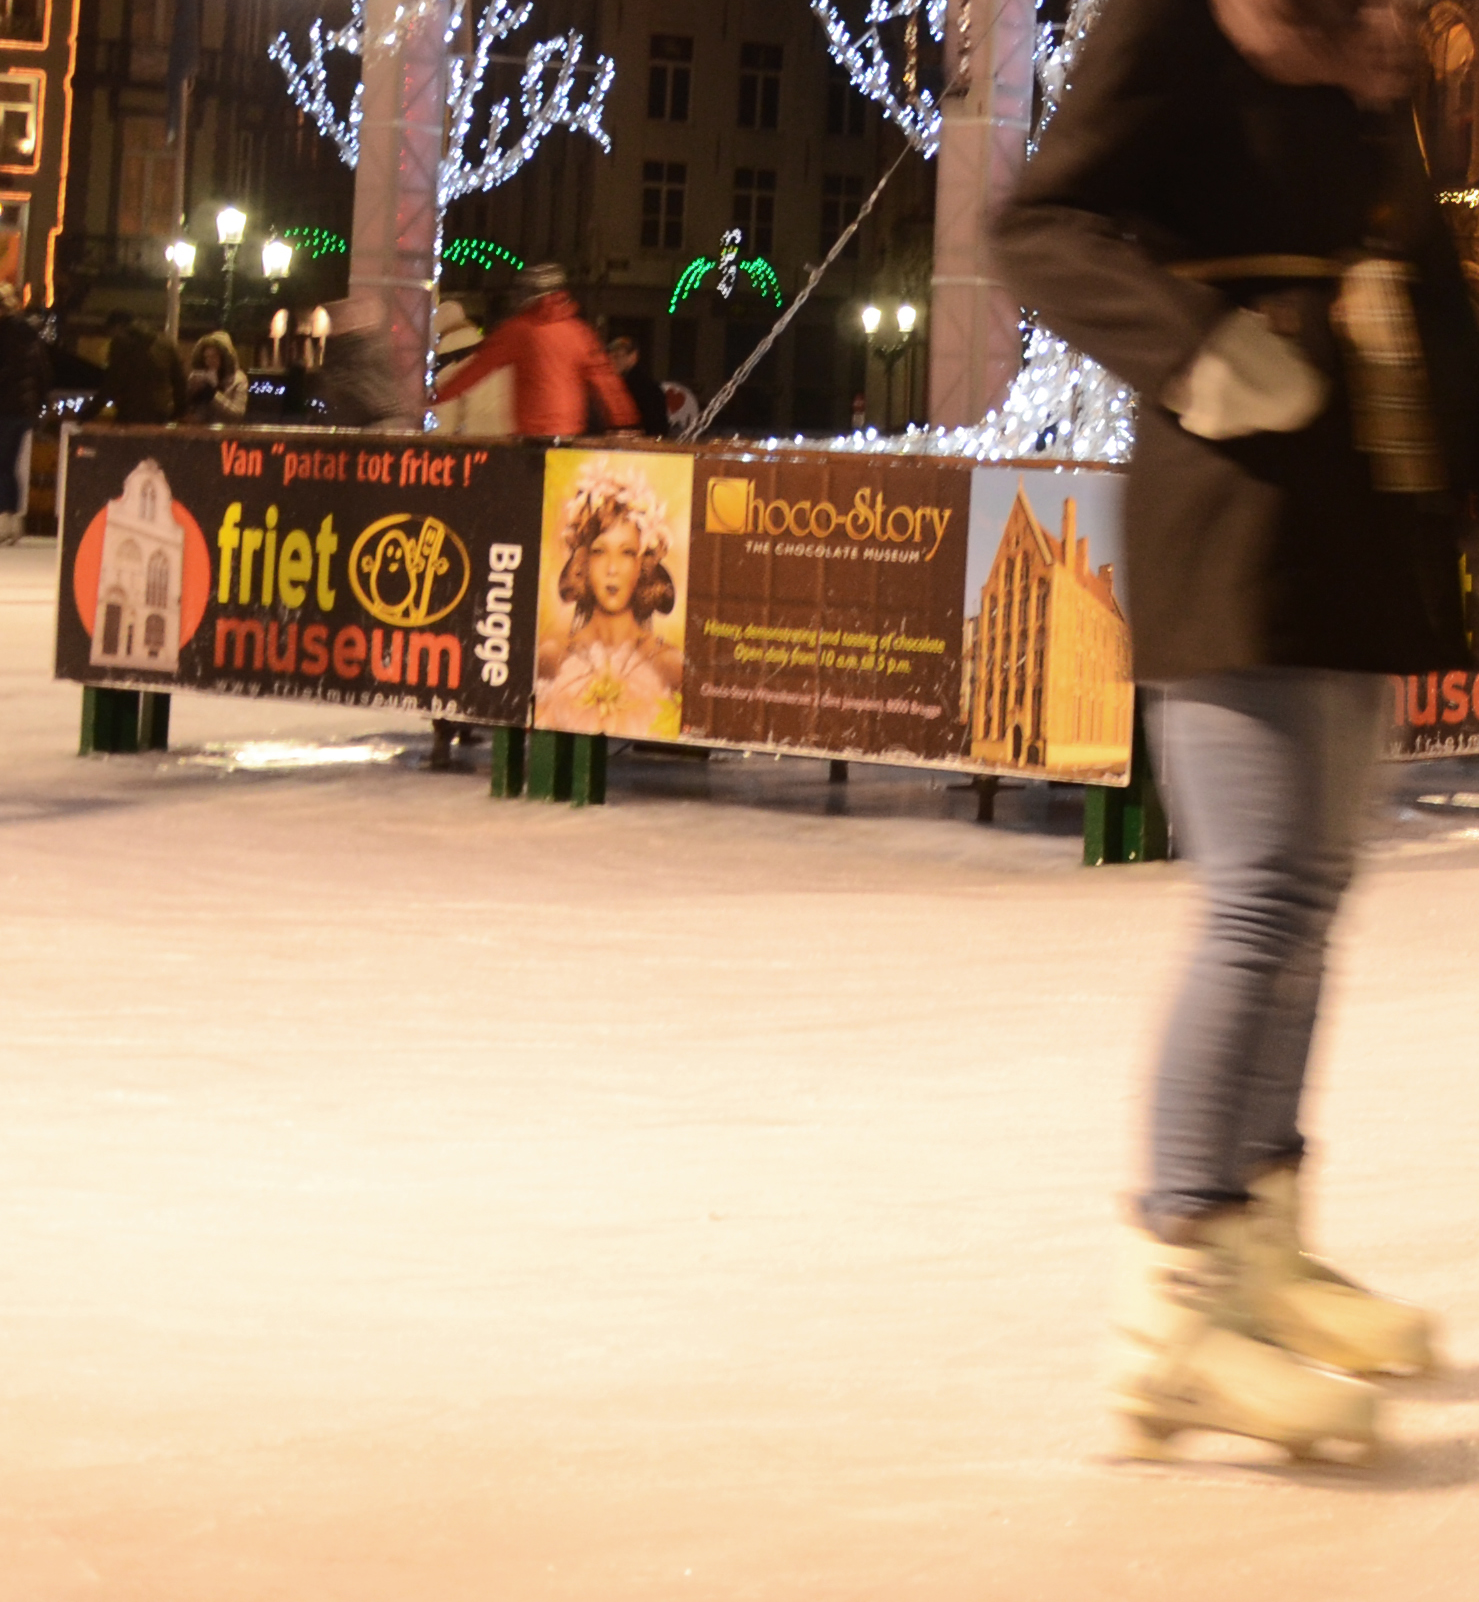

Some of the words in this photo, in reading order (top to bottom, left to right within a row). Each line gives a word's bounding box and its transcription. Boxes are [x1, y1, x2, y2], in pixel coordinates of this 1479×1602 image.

[221, 441, 263, 477] Van
[356, 451, 395, 484] tot
[399, 448, 456, 488] friet
[705, 477, 952, 562] Choco-Story
[217, 502, 338, 612] friet
[744, 541, 769, 555] THE
[775, 542, 858, 559] CHOCOLATE
[863, 546, 921, 563] MUSEUM
[474, 542, 523, 687] Brugge
[819, 629, 841, 646] and
[879, 631, 896, 653] of
[893, 634, 946, 654] chocolate
[213, 618, 462, 689] museum
[734, 643, 764, 665] Open
[820, 650, 835, 668] 10
